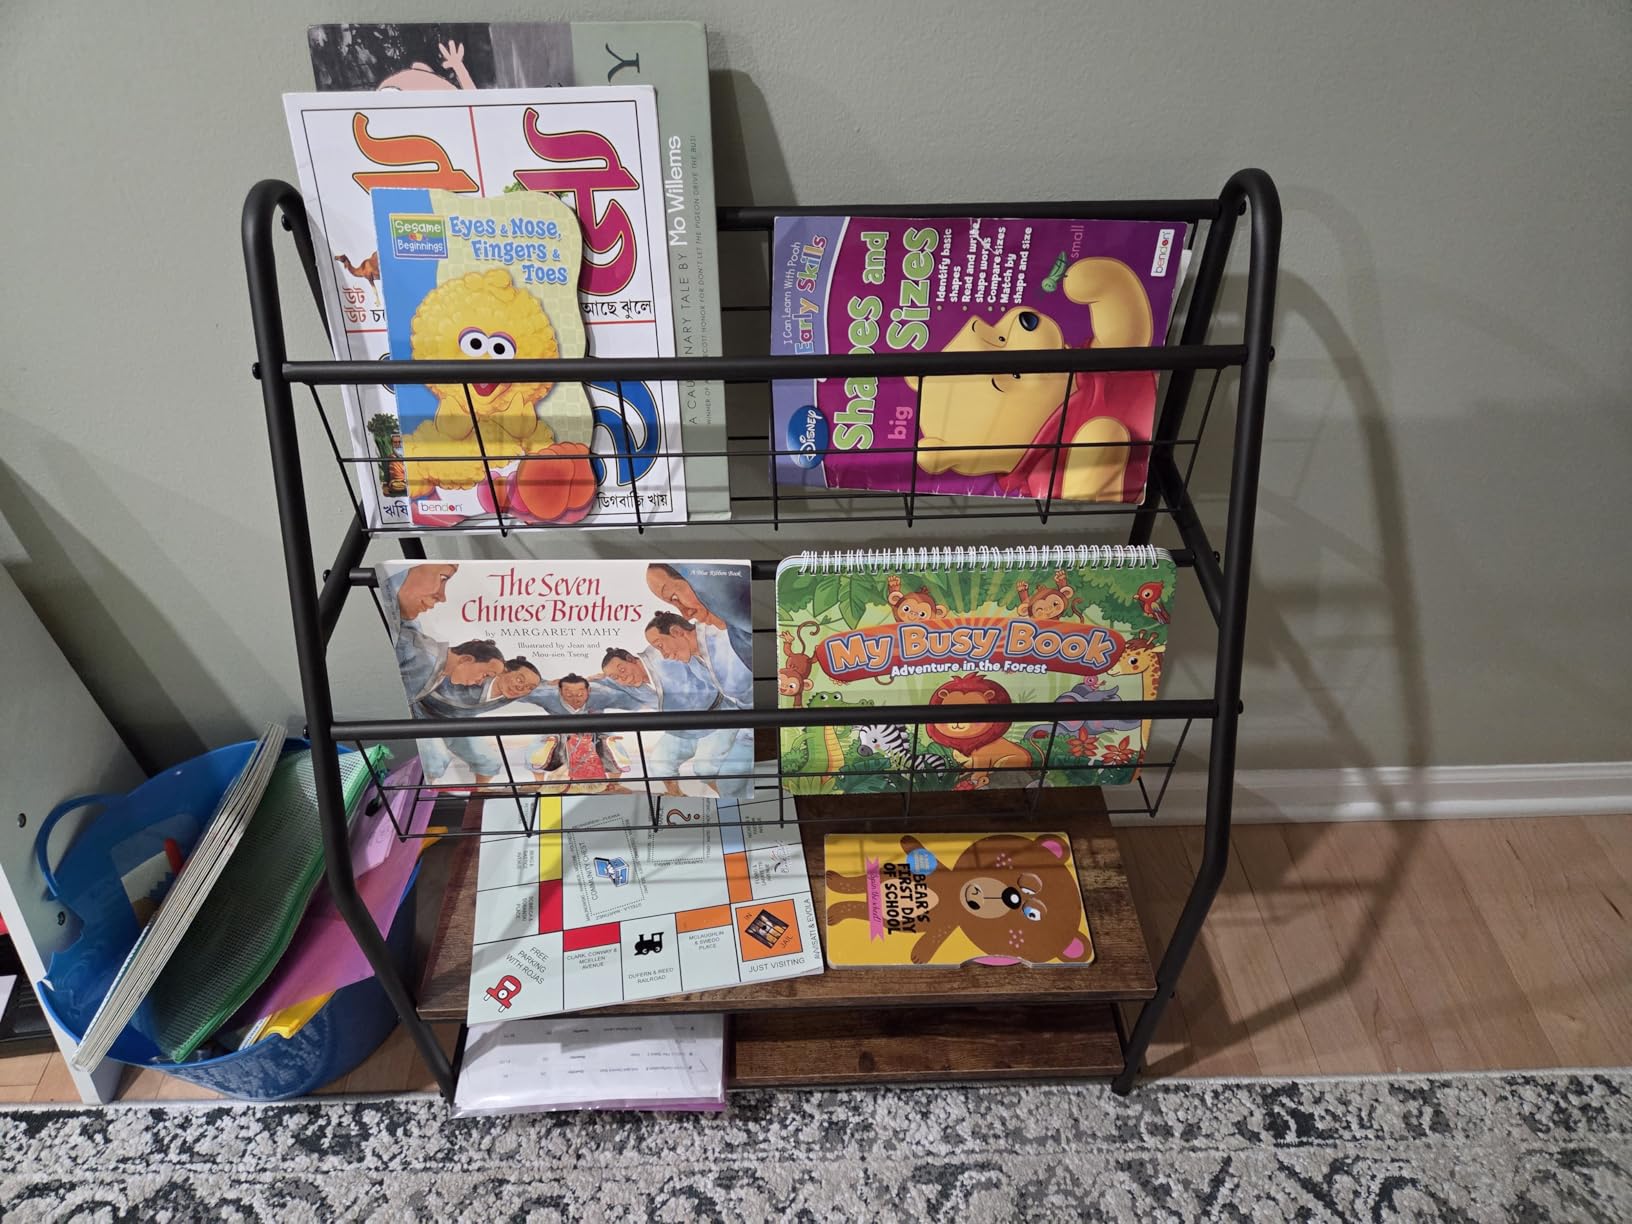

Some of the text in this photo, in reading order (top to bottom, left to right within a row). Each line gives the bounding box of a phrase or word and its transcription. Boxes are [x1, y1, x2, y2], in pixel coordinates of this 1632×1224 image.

[664, 136, 685, 213] Willems
[694, 198, 702, 229] PIGEON
[394, 219, 443, 235] Sesame
[449, 215, 563, 241] Eyes & Nose,
[668, 217, 688, 246] Mo
[397, 238, 445, 254] Beginnings
[471, 238, 561, 263] Fingers &
[786, 241, 801, 267] Pooh
[1070, 224, 1085, 259] small
[1156, 232, 1171, 274] bendon
[678, 253, 689, 270] BY
[860, 231, 889, 284] and
[936, 228, 952, 302] Identify basic
[966, 255, 976, 274] and
[987, 226, 1006, 303] Compare sizes
[1013, 226, 1033, 304] shape and size
[521, 263, 568, 285] Toes
[783, 268, 795, 289] With
[949, 266, 962, 302] shapes
[1000, 253, 1016, 303] Match by
[679, 277, 691, 310] TALE
[793, 236, 827, 354] Early Skills
[886, 227, 939, 351] Sizes
[962, 276, 973, 302] Read
[975, 272, 988, 303] shape
[781, 291, 792, 318] Learn
[782, 319, 793, 338] Can
[682, 317, 697, 409] CAUNARY
[888, 406, 913, 440] big
[421, 502, 463, 513] bendon
[488, 567, 601, 598] The Seven
[461, 596, 644, 624] Chinese Brothers
[485, 627, 622, 639] by MARGARET MAHY
[518, 641, 553, 649] Illustrated
[555, 641, 564, 650] by
[568, 650, 590, 659] Tseng
[826, 620, 1117, 675] My Busy Book
[891, 660, 1048, 678] Adventure in the Forest
[582, 862, 599, 901] COMMUNITY
[871, 890, 881, 900] the
[883, 862, 900, 936] OF SCHOOL
[897, 862, 916, 934] FIRST DAY
[913, 873, 930, 923] BEAR'S
[744, 912, 753, 920] IN
[804, 898, 814, 923] EVOLA
[688, 930, 725, 942] MCLAUGHLIN
[698, 943, 718, 951] PLACE
[780, 935, 794, 949] JAIL
[518, 950, 547, 974] PARKING
[528, 946, 550, 963] FREE
[749, 957, 806, 973] JUST VISITING
[505, 954, 546, 986] WITH ROJAS
[637, 975, 667, 984] RAILROAD
